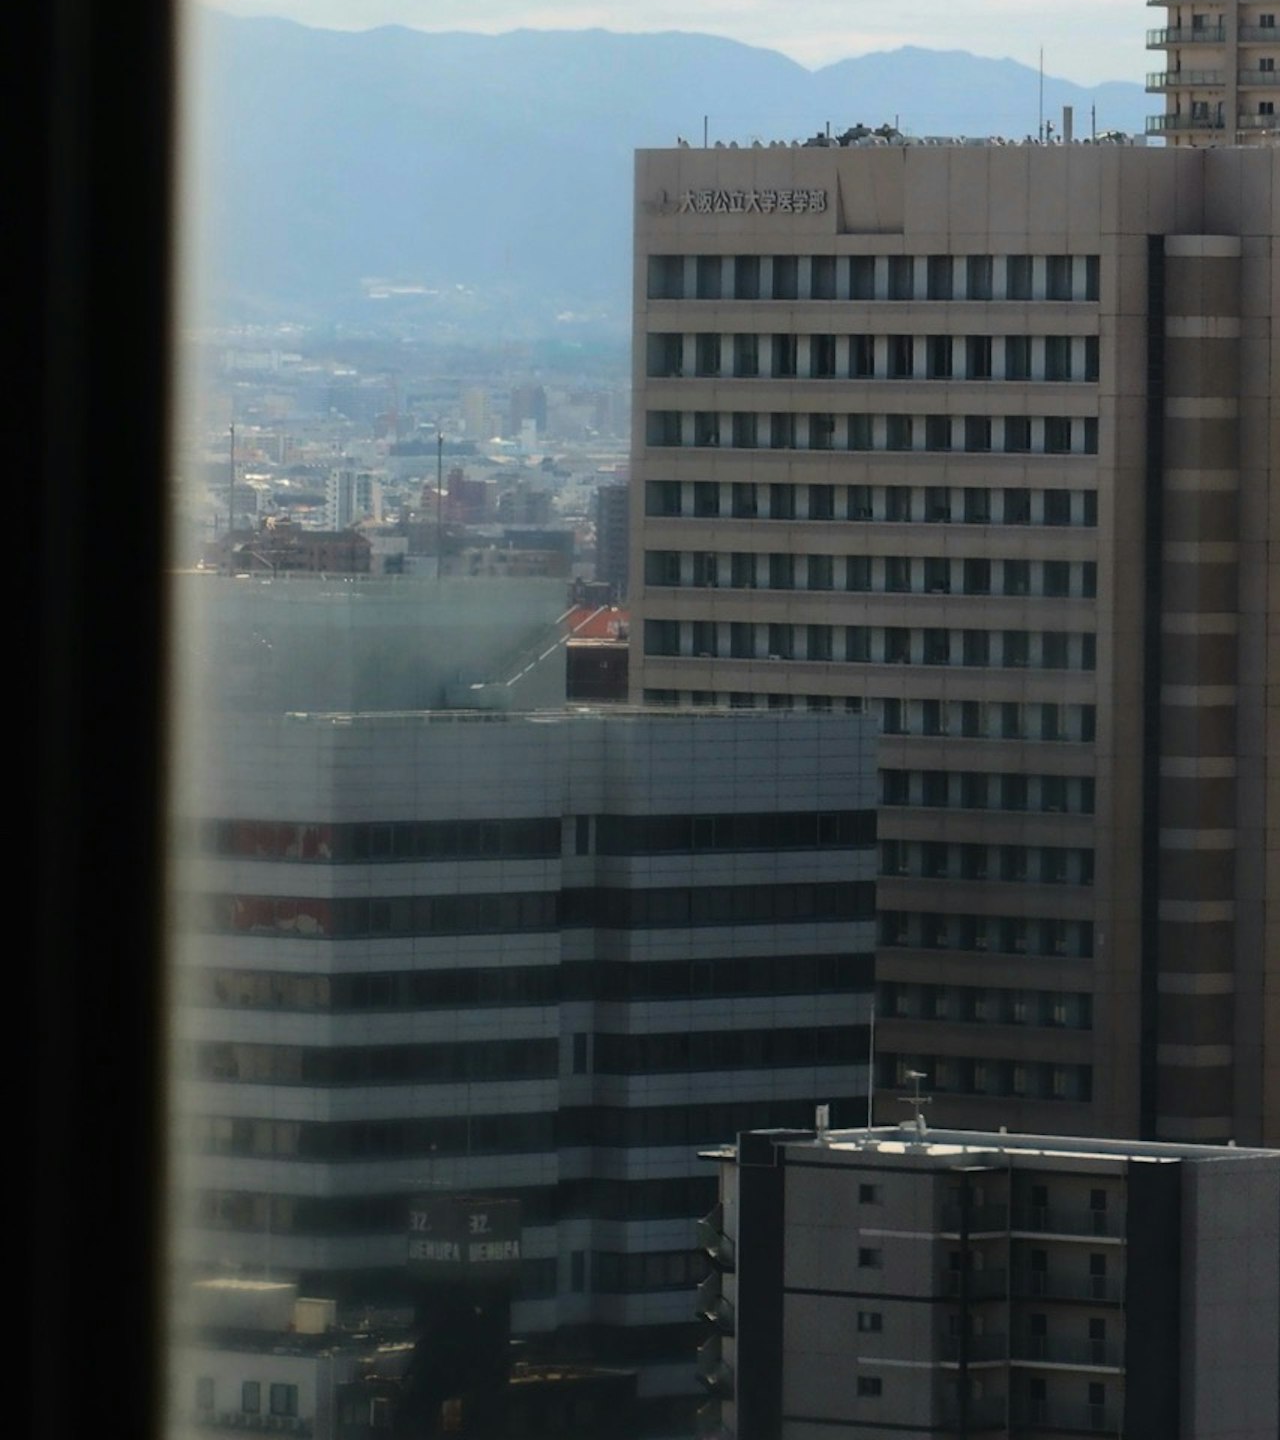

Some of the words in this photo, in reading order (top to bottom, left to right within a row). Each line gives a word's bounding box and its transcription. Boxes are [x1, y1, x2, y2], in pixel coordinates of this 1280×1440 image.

[680, 190, 827, 213] 大阪公立大学医学部
